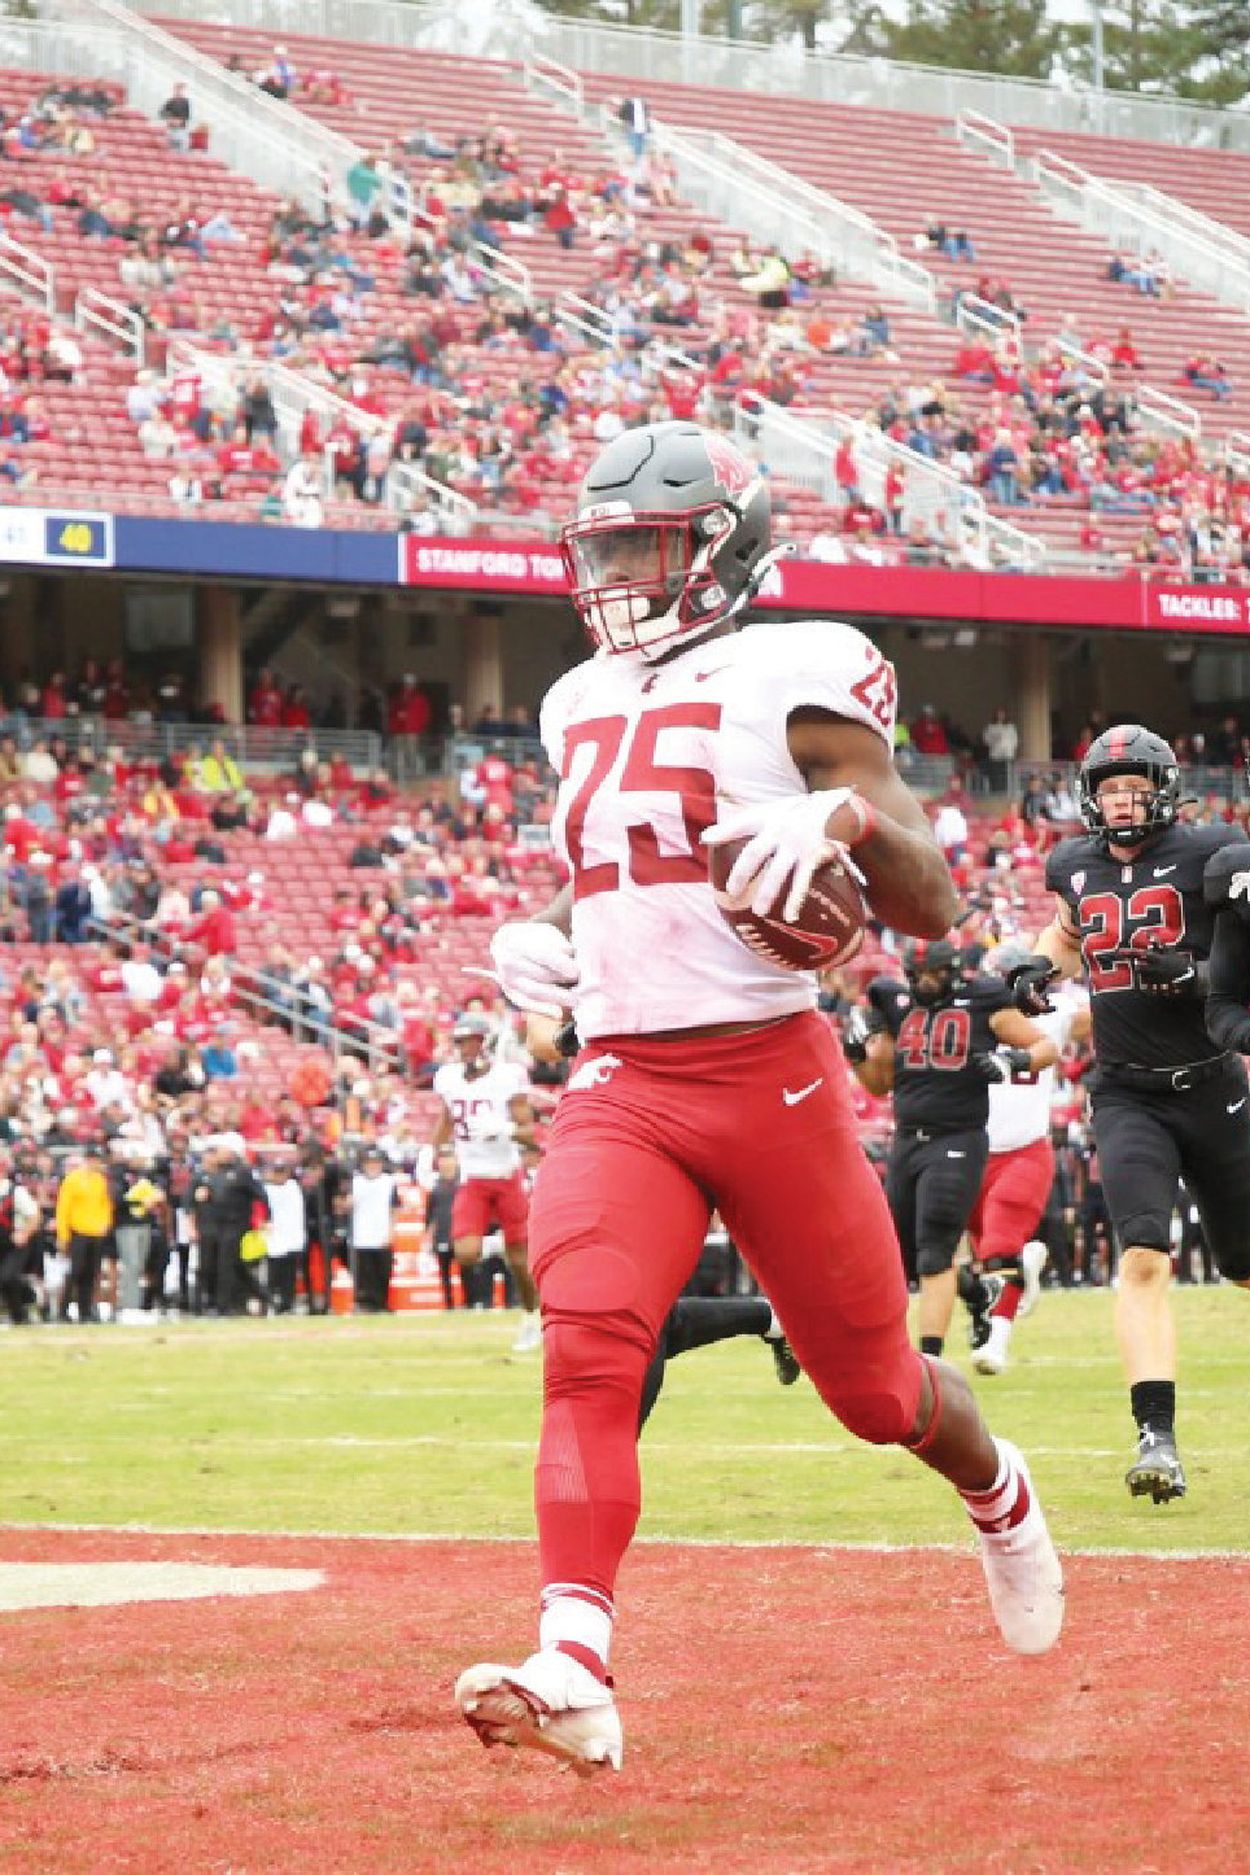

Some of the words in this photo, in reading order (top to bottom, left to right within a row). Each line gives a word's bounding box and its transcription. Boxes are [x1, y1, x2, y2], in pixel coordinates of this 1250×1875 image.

[417, 547, 527, 576] STANFORD
[1159, 593, 1241, 620] TACKLES:
[561, 701, 722, 900] 25
[1079, 882, 1186, 995] 22
[897, 1007, 971, 1071] 40
